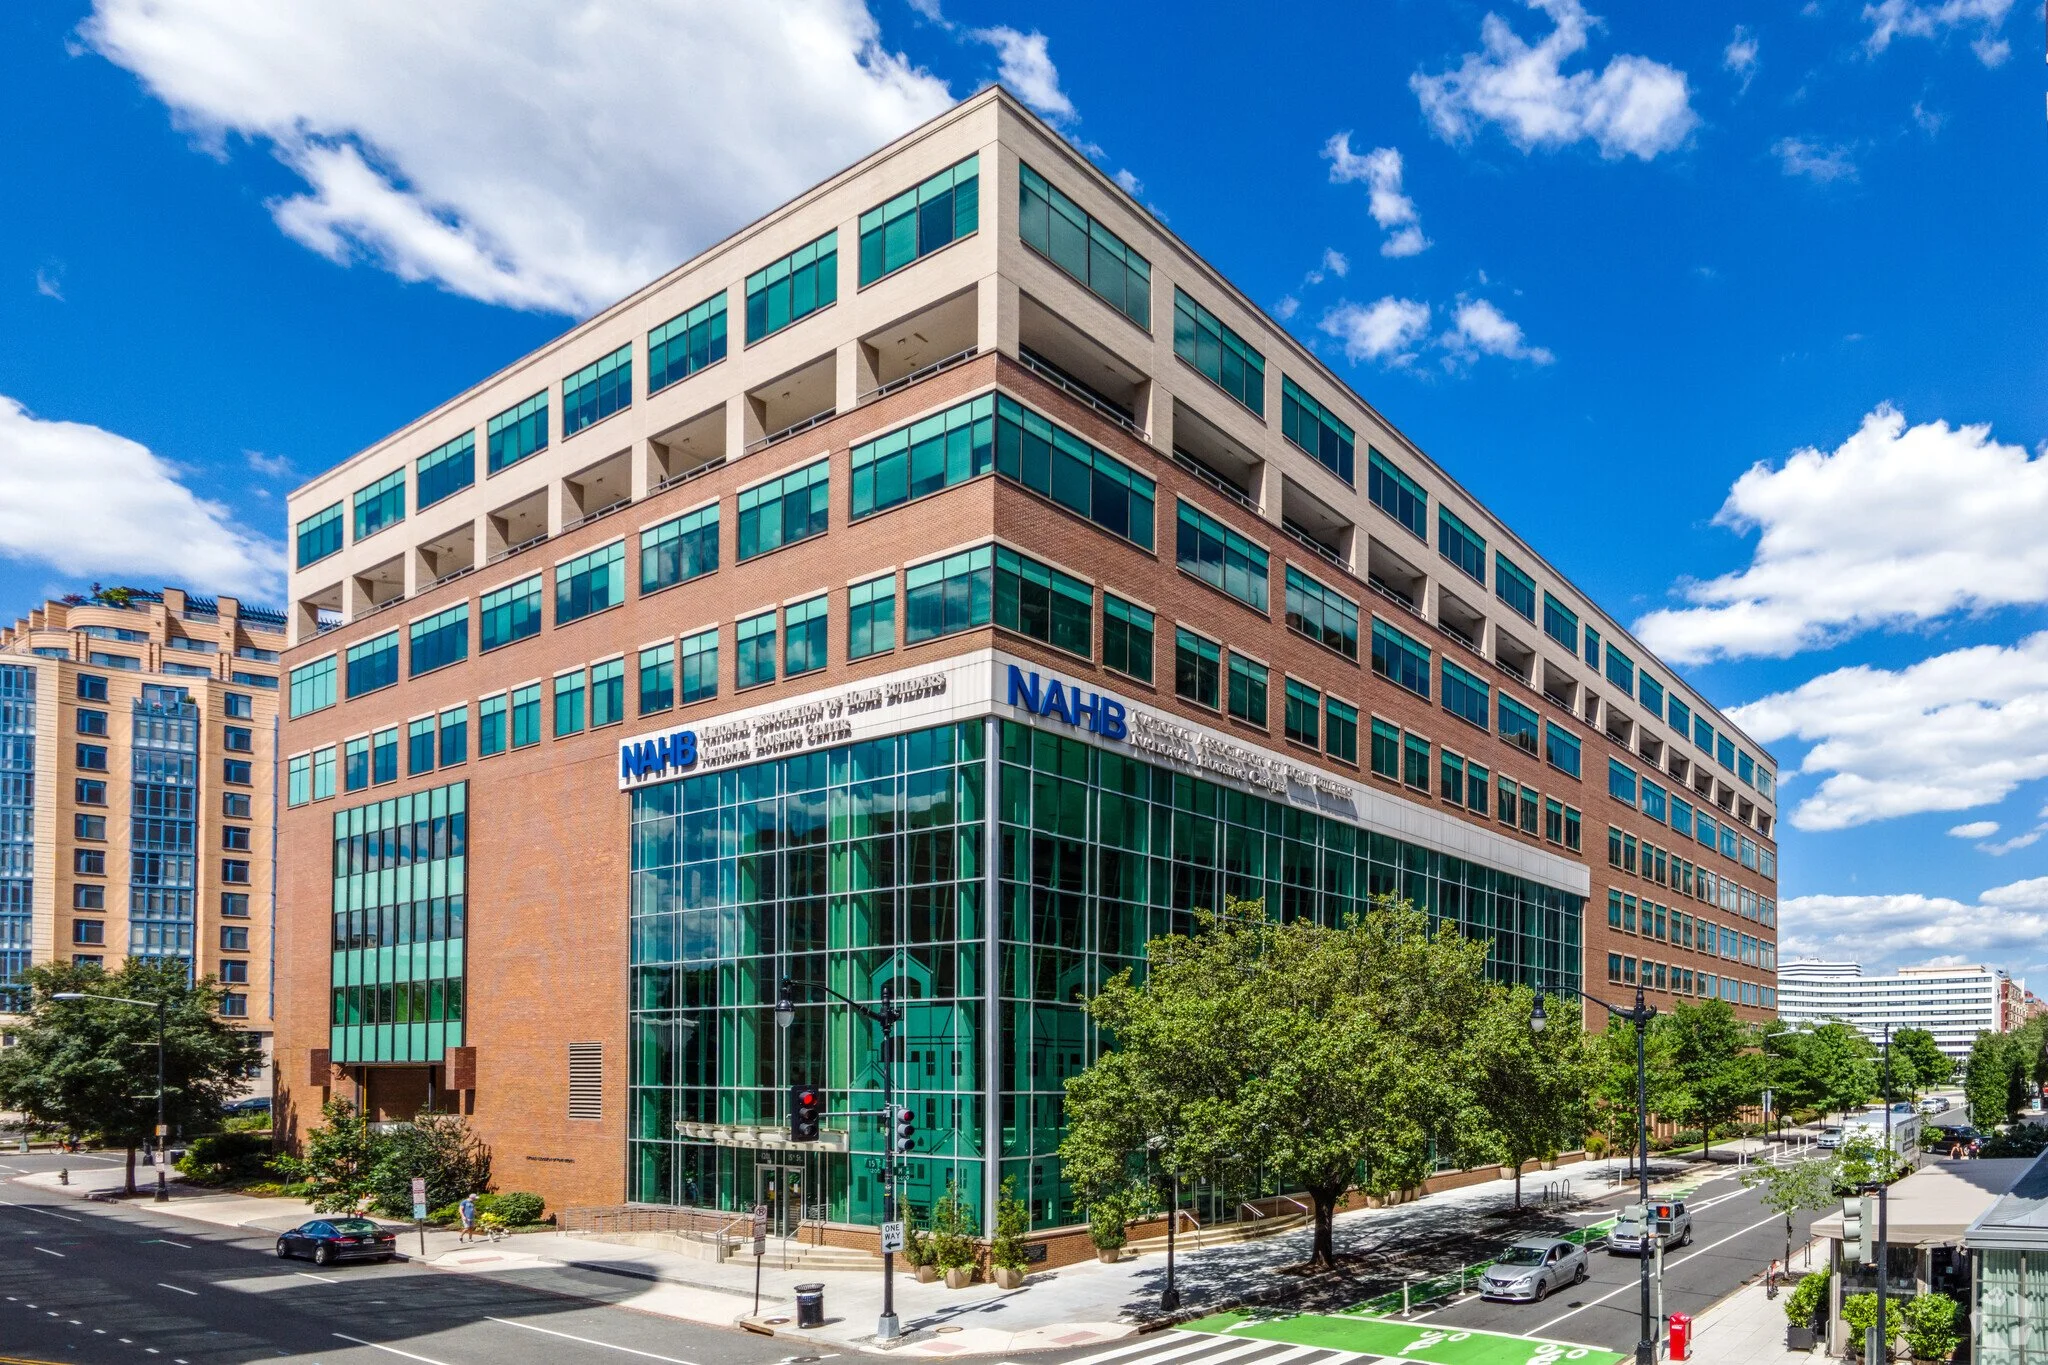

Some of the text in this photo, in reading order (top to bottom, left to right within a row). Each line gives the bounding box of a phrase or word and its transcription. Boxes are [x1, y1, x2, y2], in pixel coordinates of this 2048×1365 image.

[700, 720, 750, 744] NATIONAL
[752, 703, 823, 732] ASSOCIATION
[845, 687, 882, 711] HOME
[884, 672, 946, 703] BUILDERS
[1008, 664, 1127, 740] NAHB
[622, 731, 697, 778] NAHB
[700, 719, 852, 765] NATIONAL HOUSING CENTER
[1130, 707, 1193, 743] NATIONAL
[1196, 732, 1265, 766] ASSOCIATION
[1130, 729, 1287, 794] NATIONAL HOUSING CENTER
[885, 1224, 900, 1232] ONE
[885, 1232, 900, 1240] WAY
